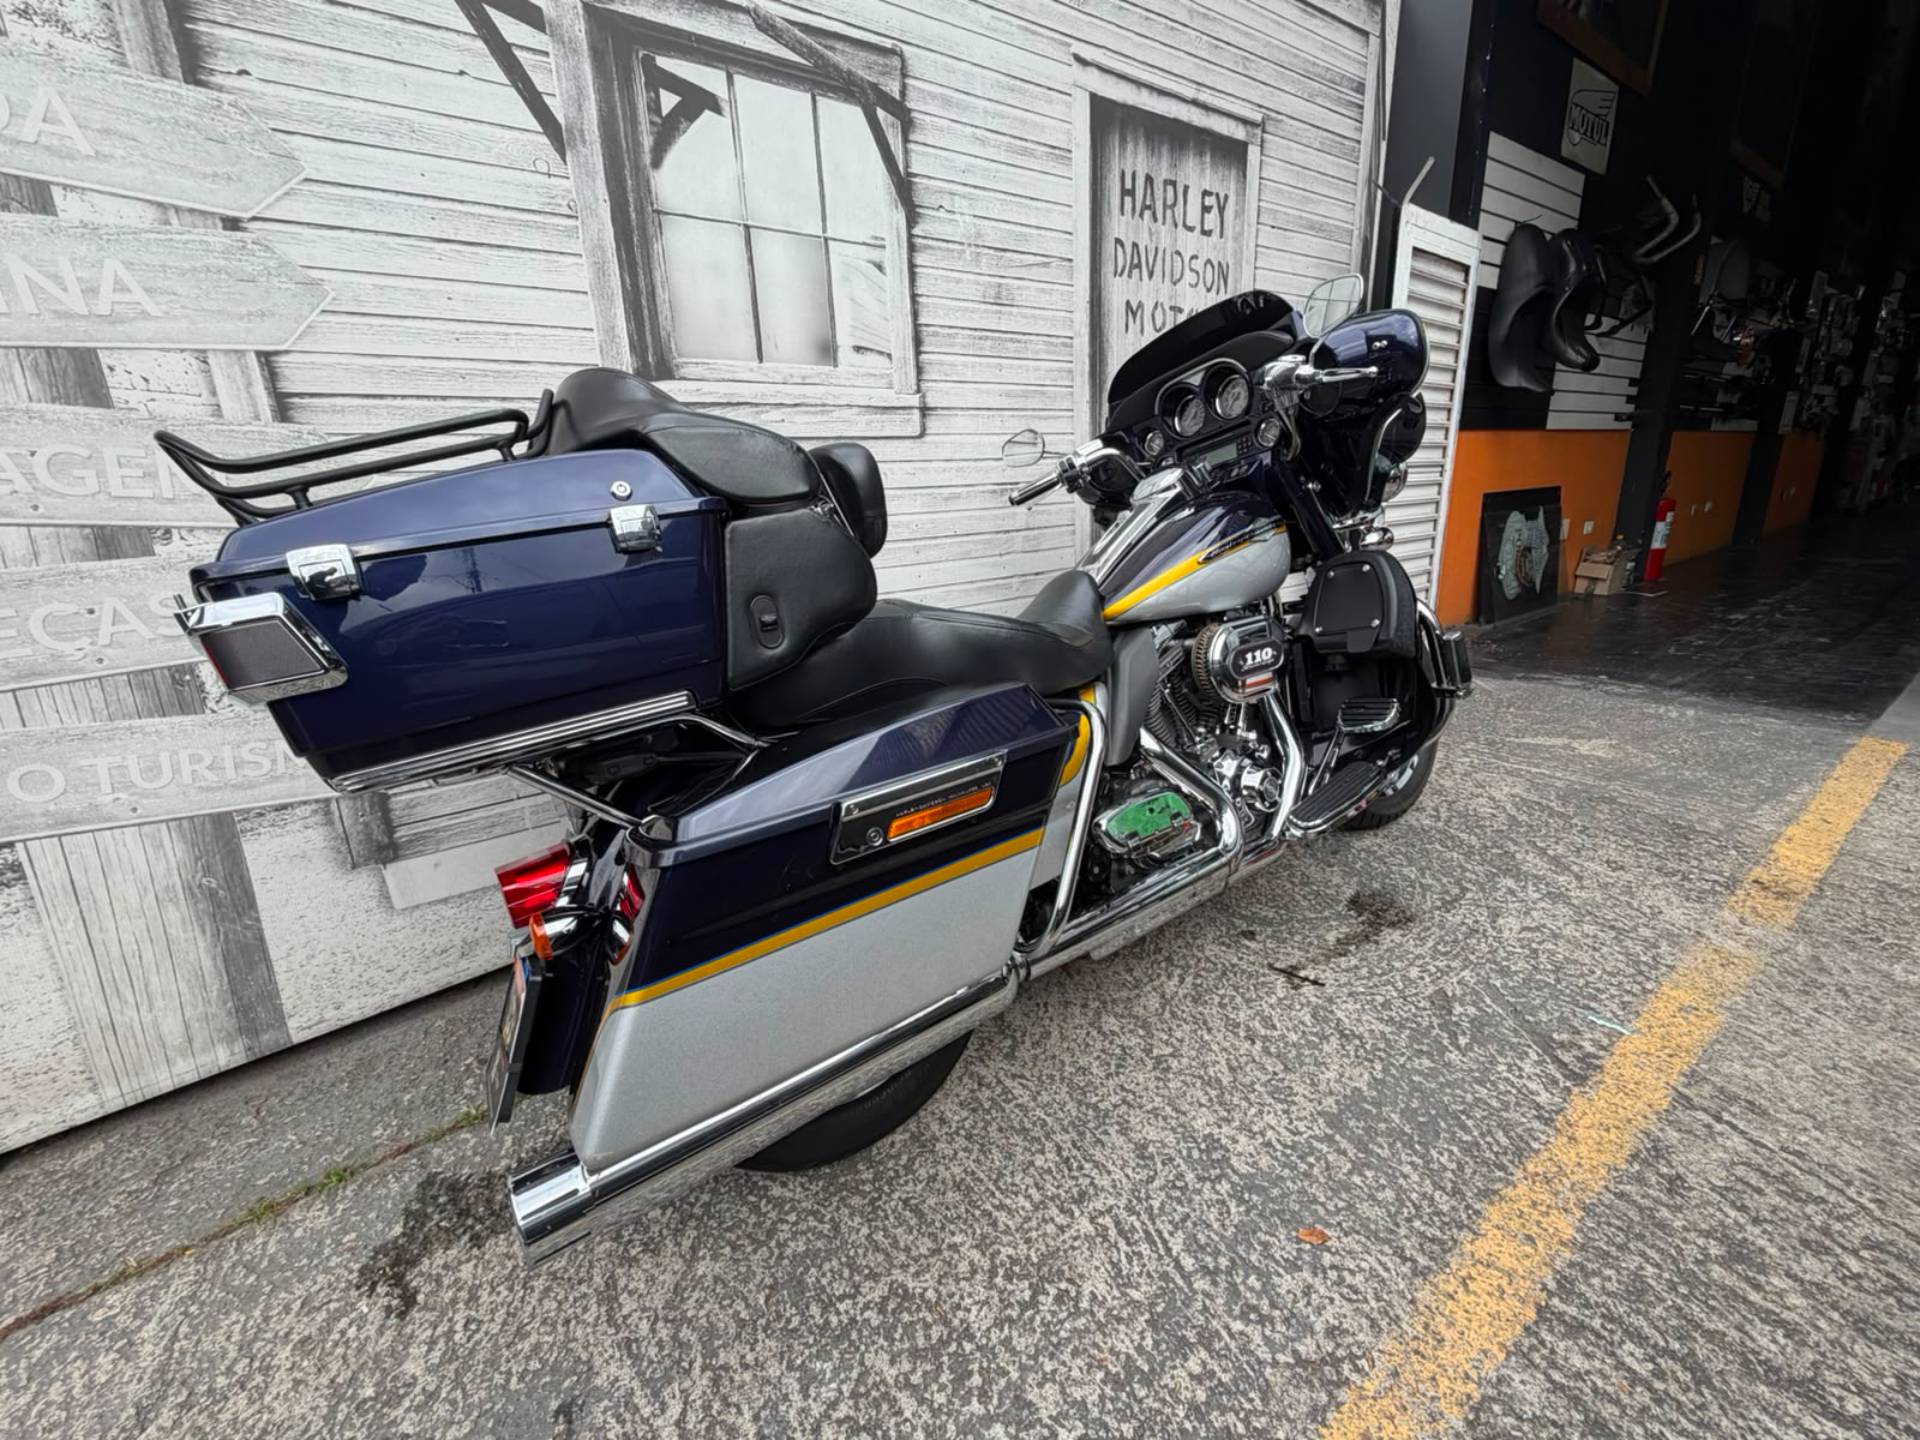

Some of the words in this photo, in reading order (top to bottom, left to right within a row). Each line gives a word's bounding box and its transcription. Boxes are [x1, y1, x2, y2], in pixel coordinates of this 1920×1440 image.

[0, 86, 97, 157] A
[1120, 168, 1229, 239] HARLEY
[0, 252, 163, 316] NA
[1113, 237, 1230, 296] DAVIDSON
[1124, 299, 1200, 336] MOT
[1245, 646, 1273, 666] 110
[6, 763, 66, 802] O
